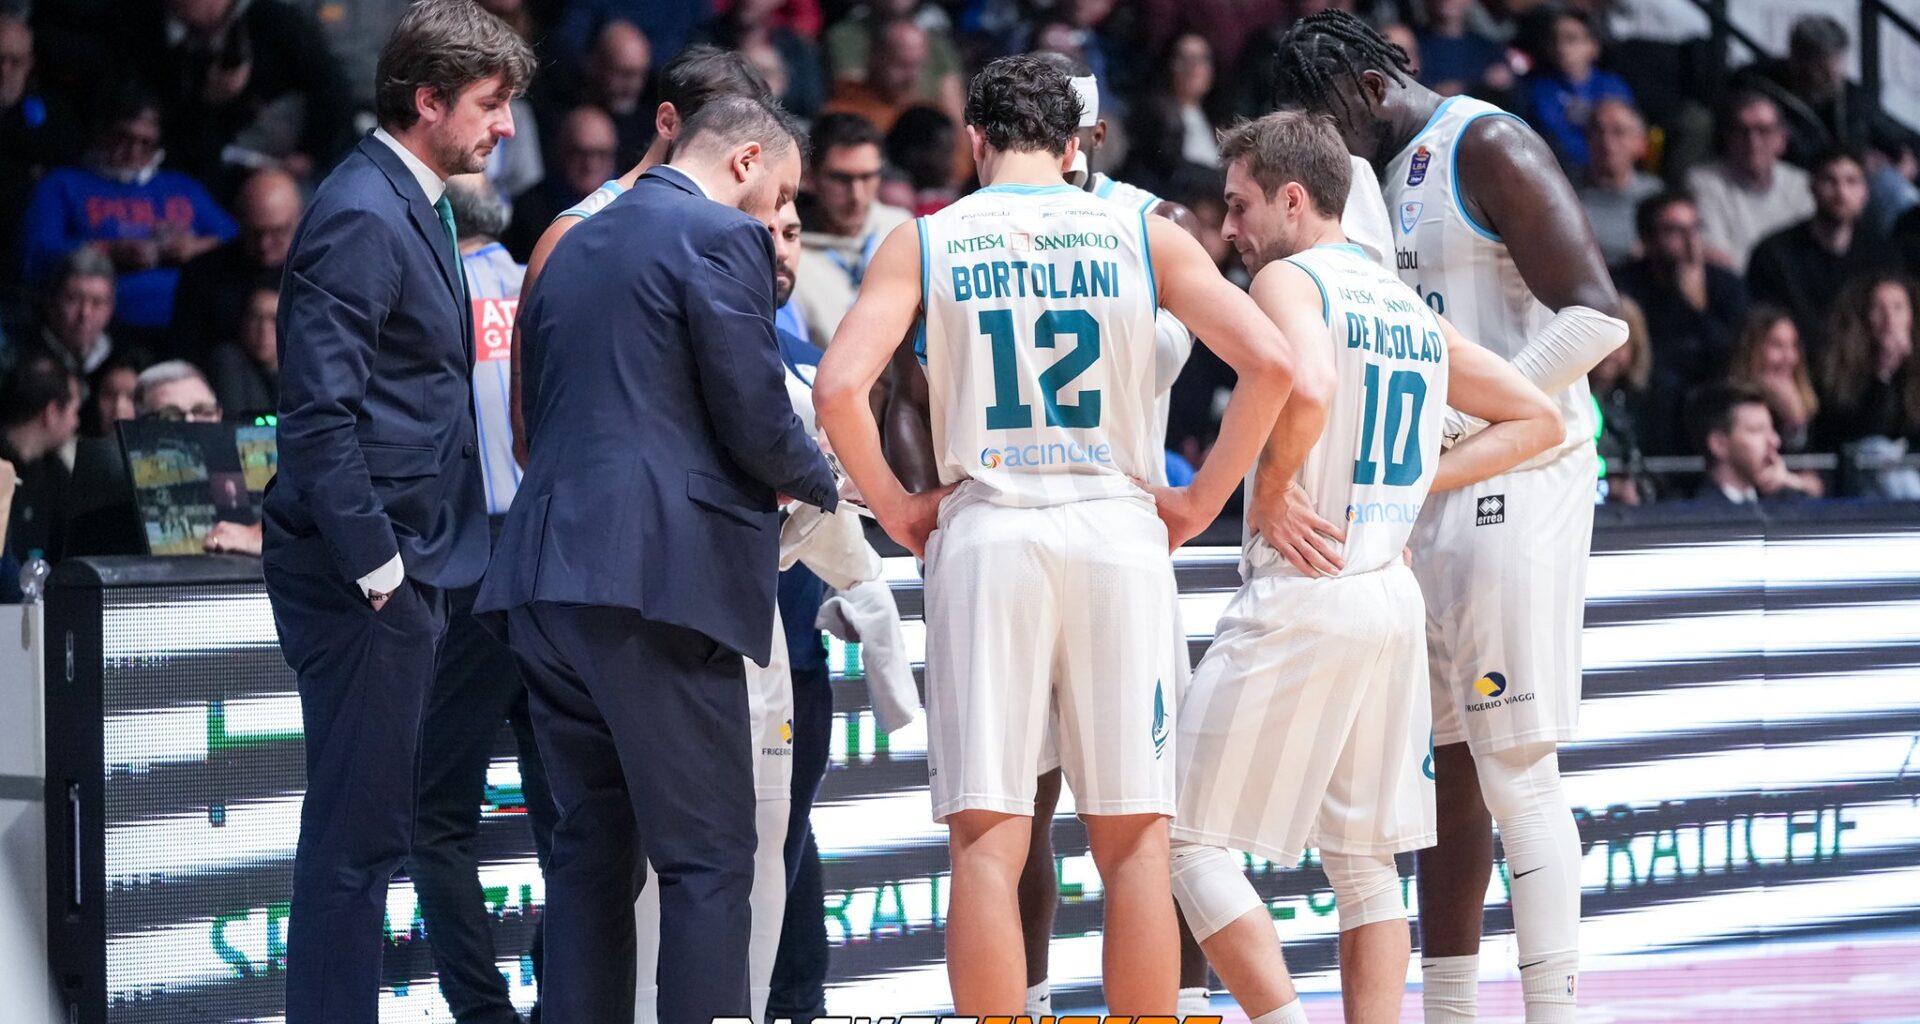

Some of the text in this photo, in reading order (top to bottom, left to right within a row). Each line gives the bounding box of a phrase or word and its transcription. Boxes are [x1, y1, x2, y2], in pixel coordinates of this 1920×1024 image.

[947, 231, 1119, 254] INTESA SANPAOLO
[1396, 246, 1418, 269] abu
[951, 260, 1120, 302] BORTOLANI
[1345, 312, 1442, 364] DE NCOLAO
[979, 309, 1102, 430] 12
[1352, 362, 1427, 487] 10
[1504, 693, 1535, 705] VIAGGI
